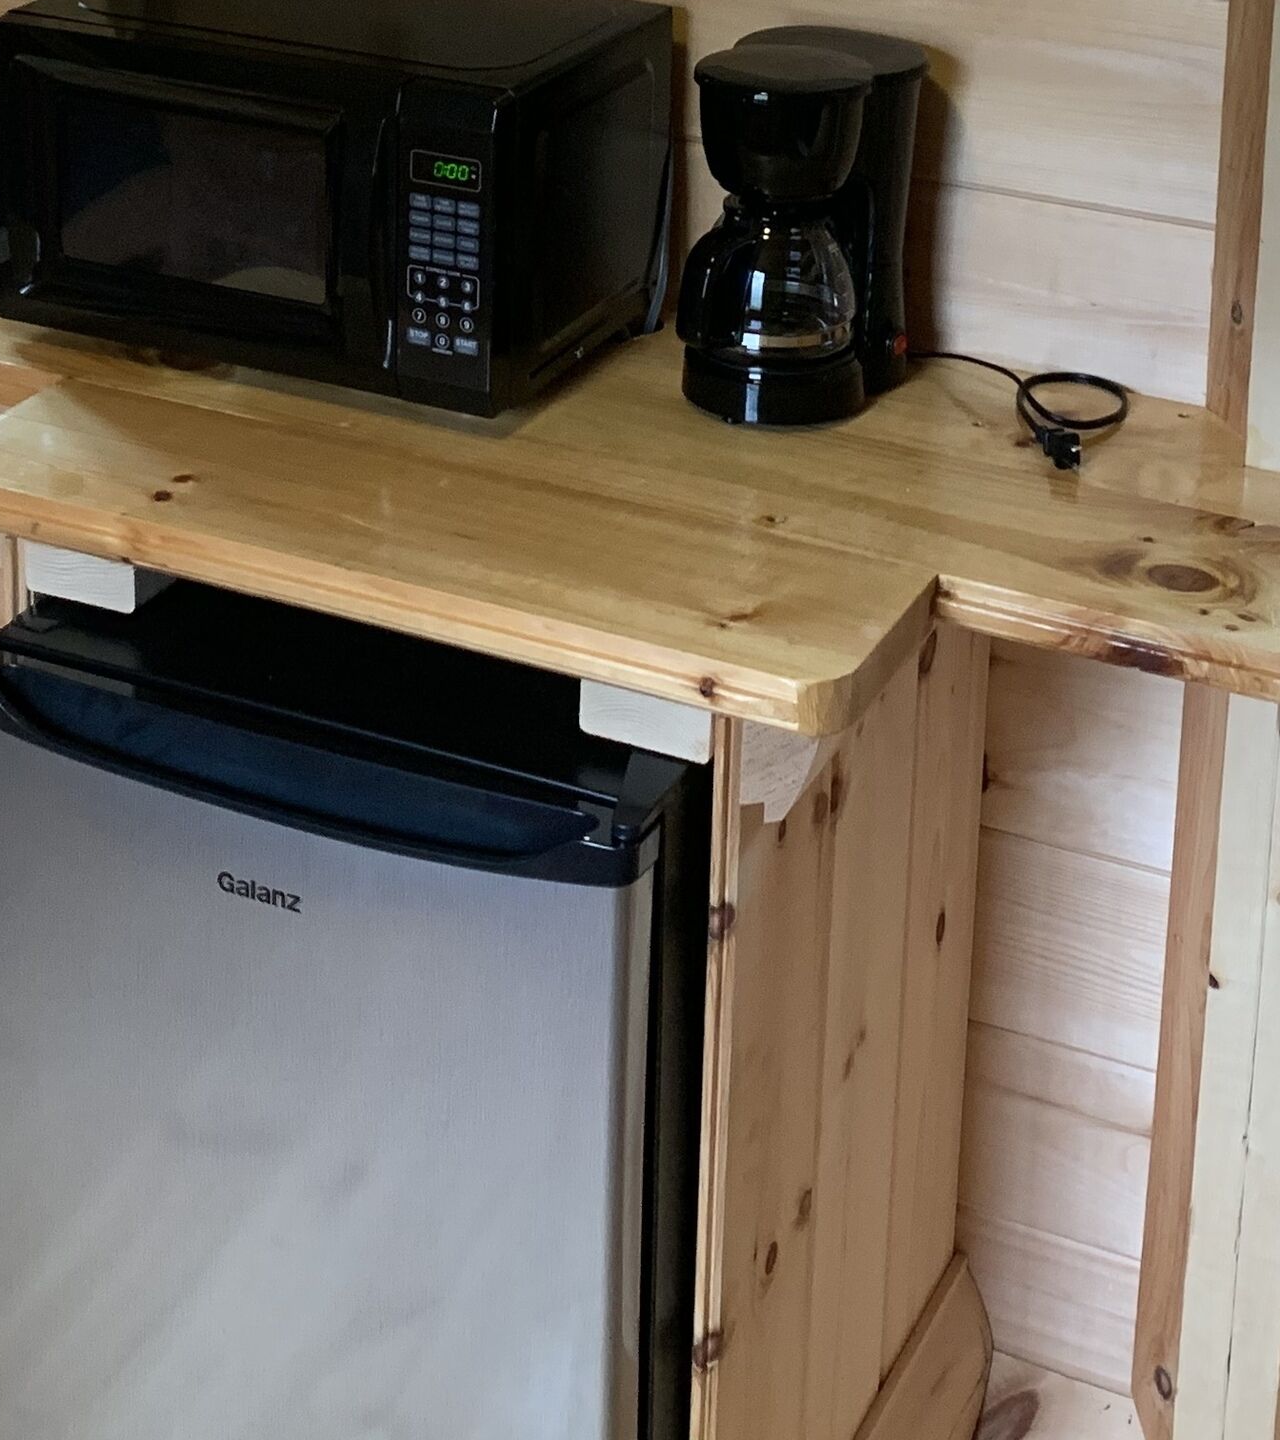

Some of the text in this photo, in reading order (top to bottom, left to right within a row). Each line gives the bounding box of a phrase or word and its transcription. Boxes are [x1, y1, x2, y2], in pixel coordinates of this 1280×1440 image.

[433, 161, 469, 181] 0:00
[409, 327, 429, 338] STOP
[455, 338, 478, 349] START
[216, 870, 302, 913] Galanz
